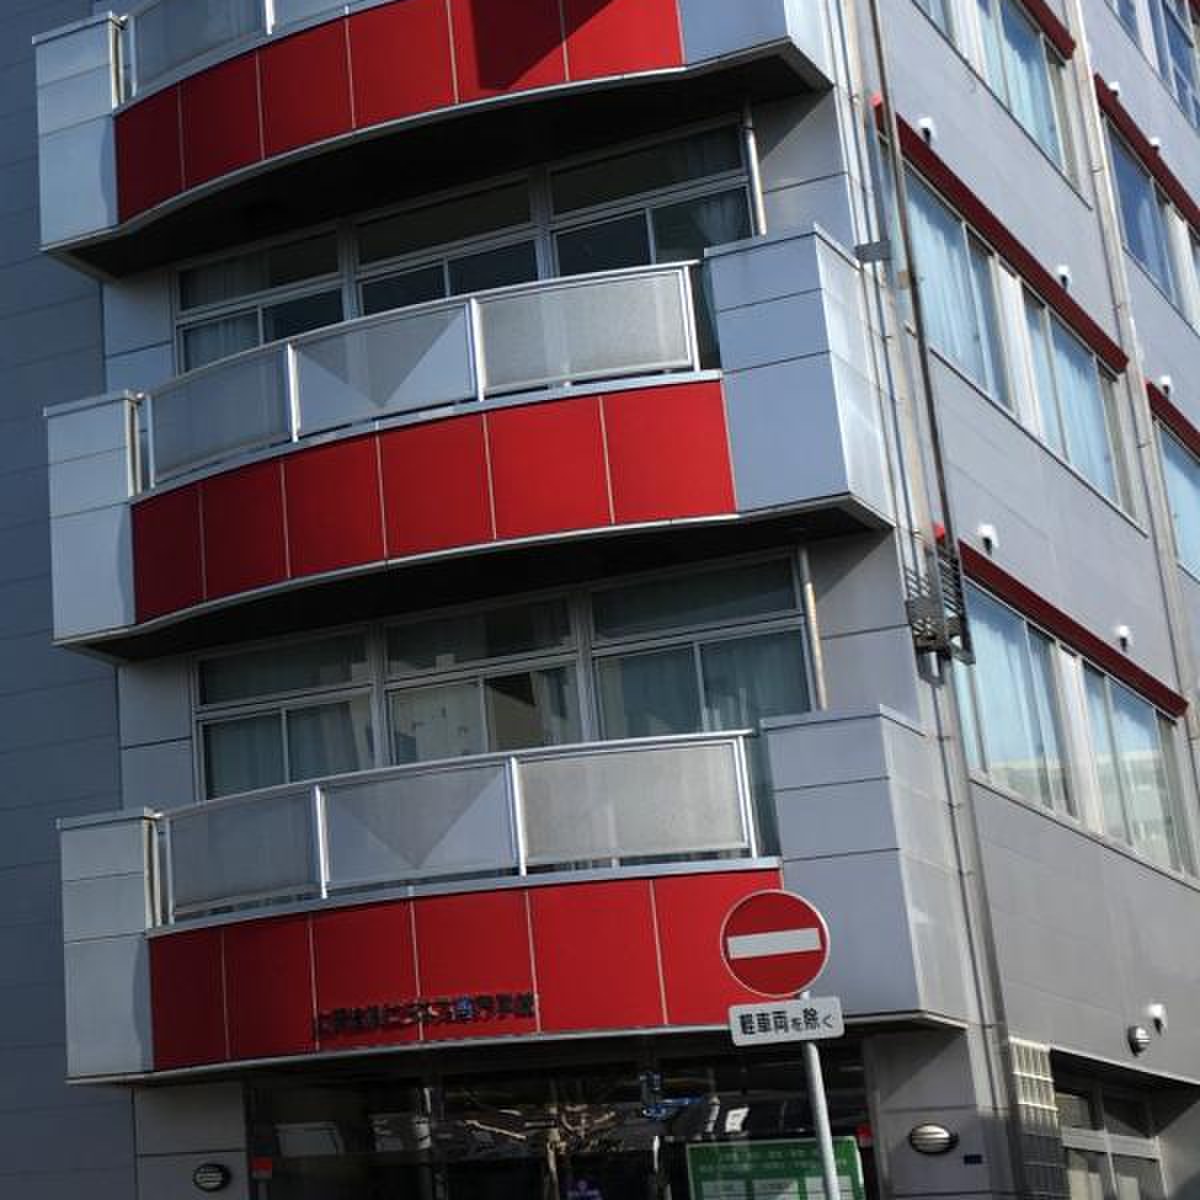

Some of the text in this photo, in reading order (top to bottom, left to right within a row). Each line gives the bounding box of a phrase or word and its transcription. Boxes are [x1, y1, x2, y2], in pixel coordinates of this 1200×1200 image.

[738, 1007, 834, 1036] 軽車両を除く
